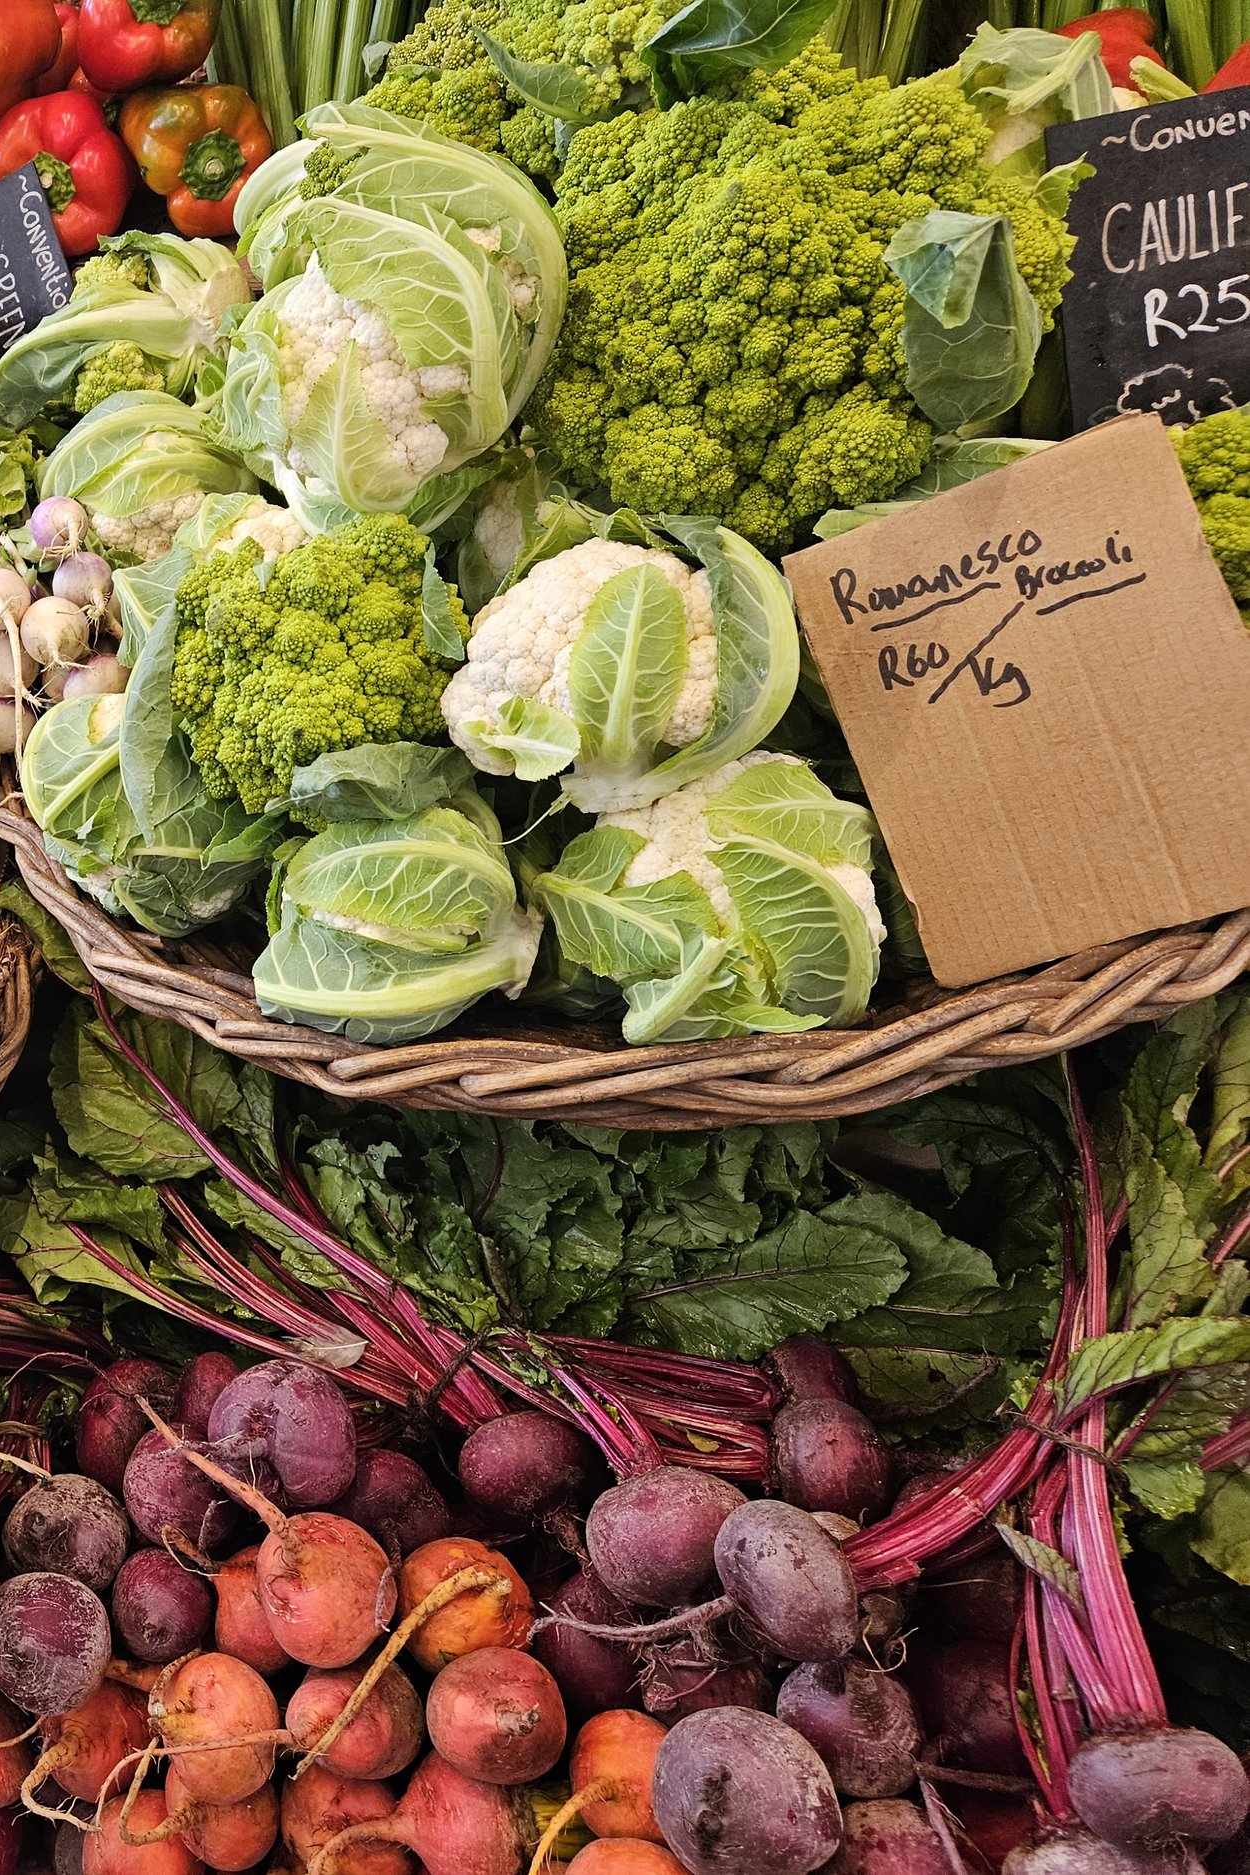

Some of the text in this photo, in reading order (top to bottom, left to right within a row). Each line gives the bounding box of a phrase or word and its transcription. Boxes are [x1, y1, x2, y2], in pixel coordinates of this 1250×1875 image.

[1101, 182, 1249, 274] CAULIF
[1143, 273, 1250, 348] R25
[829, 529, 1133, 624] Romanesco Broccoli
